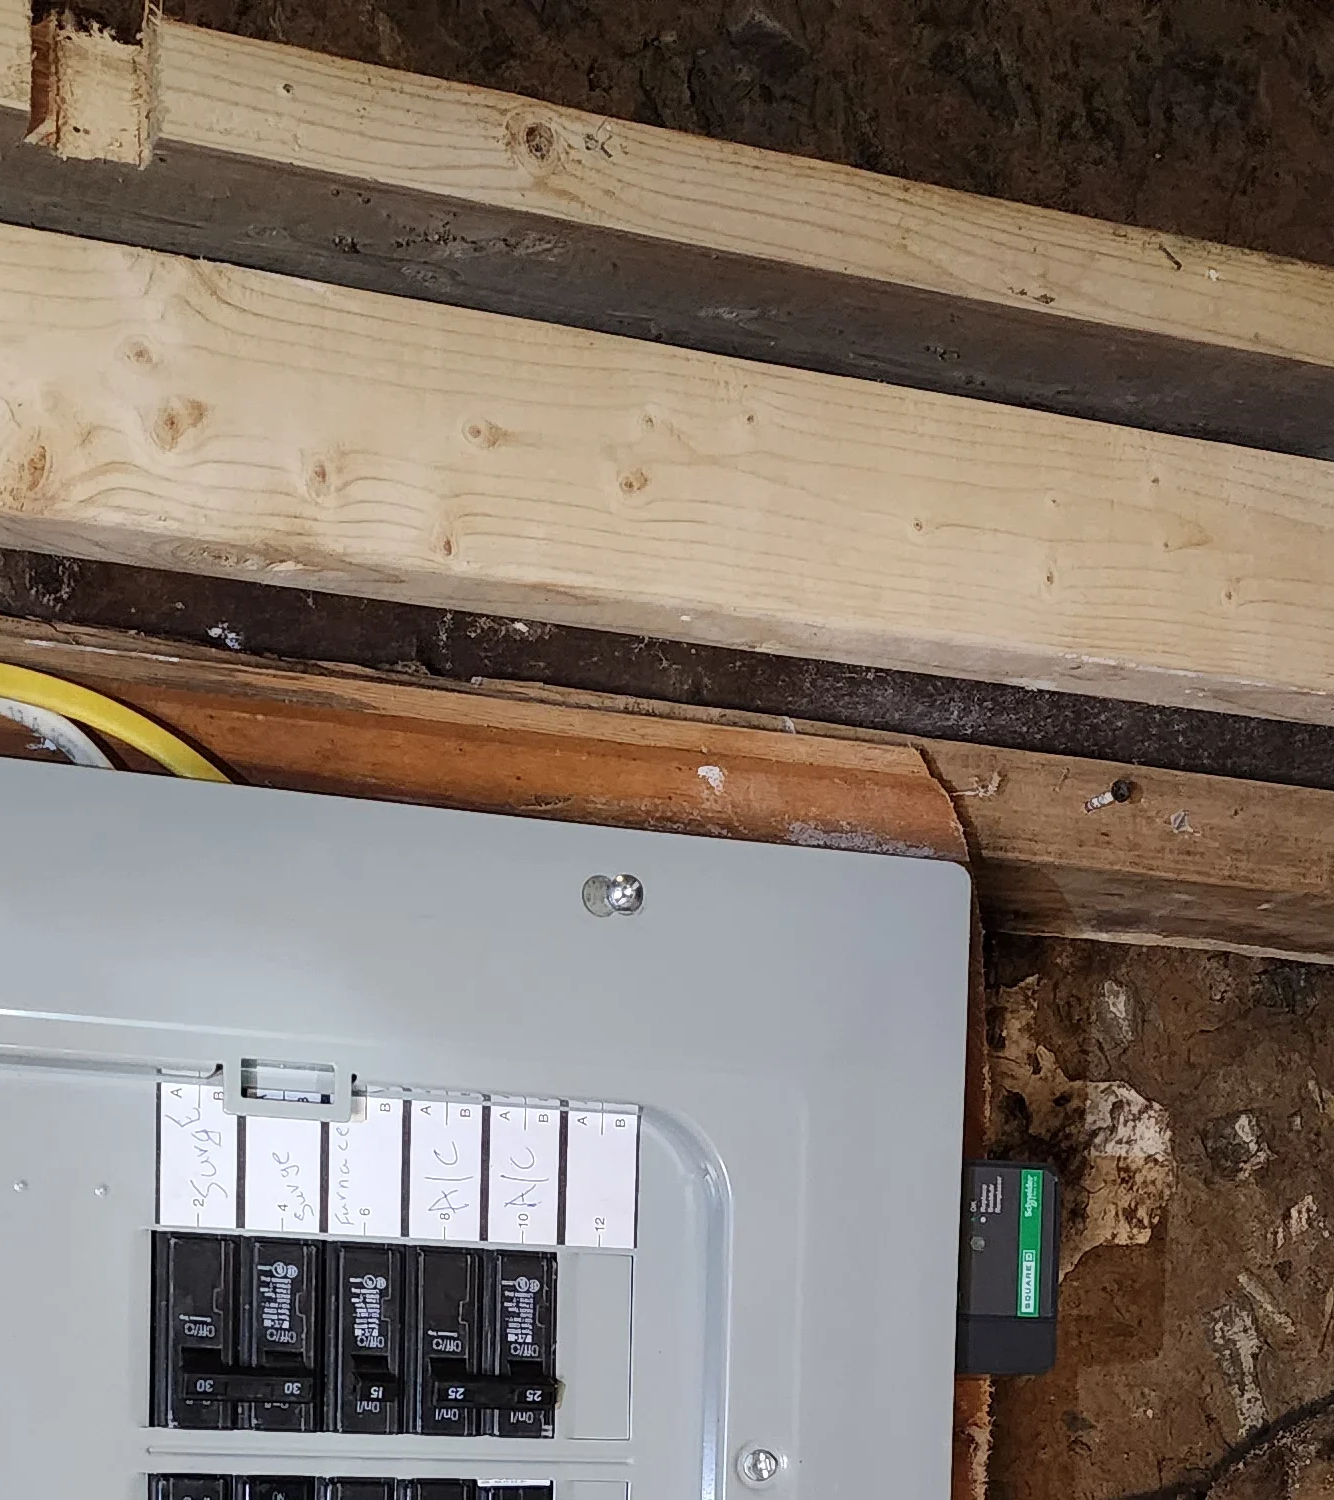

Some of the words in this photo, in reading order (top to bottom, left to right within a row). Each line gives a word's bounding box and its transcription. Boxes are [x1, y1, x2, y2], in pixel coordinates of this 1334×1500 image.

[170, 1087, 183, 1099] A
[212, 1091, 225, 1101] B
[379, 1102, 391, 1113] B
[420, 1105, 432, 1116] A
[459, 1107, 472, 1118] B
[499, 1110, 511, 1121] A
[538, 1112, 549, 1123] B
[576, 1115, 588, 1126] A
[615, 1118, 626, 1128] B
[334, 1126, 354, 1226] Furnace
[193, 1198, 205, 1208] 2
[277, 1202, 289, 1213] 4
[970, 1201, 977, 1213] OK
[359, 1207, 371, 1217] 6
[439, 1212, 451, 1221] 8
[518, 1212, 530, 1229] 10
[594, 1217, 606, 1232] 12
[1024, 1263, 1033, 1309] SQUARE
[196, 1379, 215, 1392] 30
[284, 1382, 302, 1395] 30
[370, 1386, 383, 1398] 15
[448, 1387, 465, 1400] 25
[526, 1389, 543, 1401] 25
